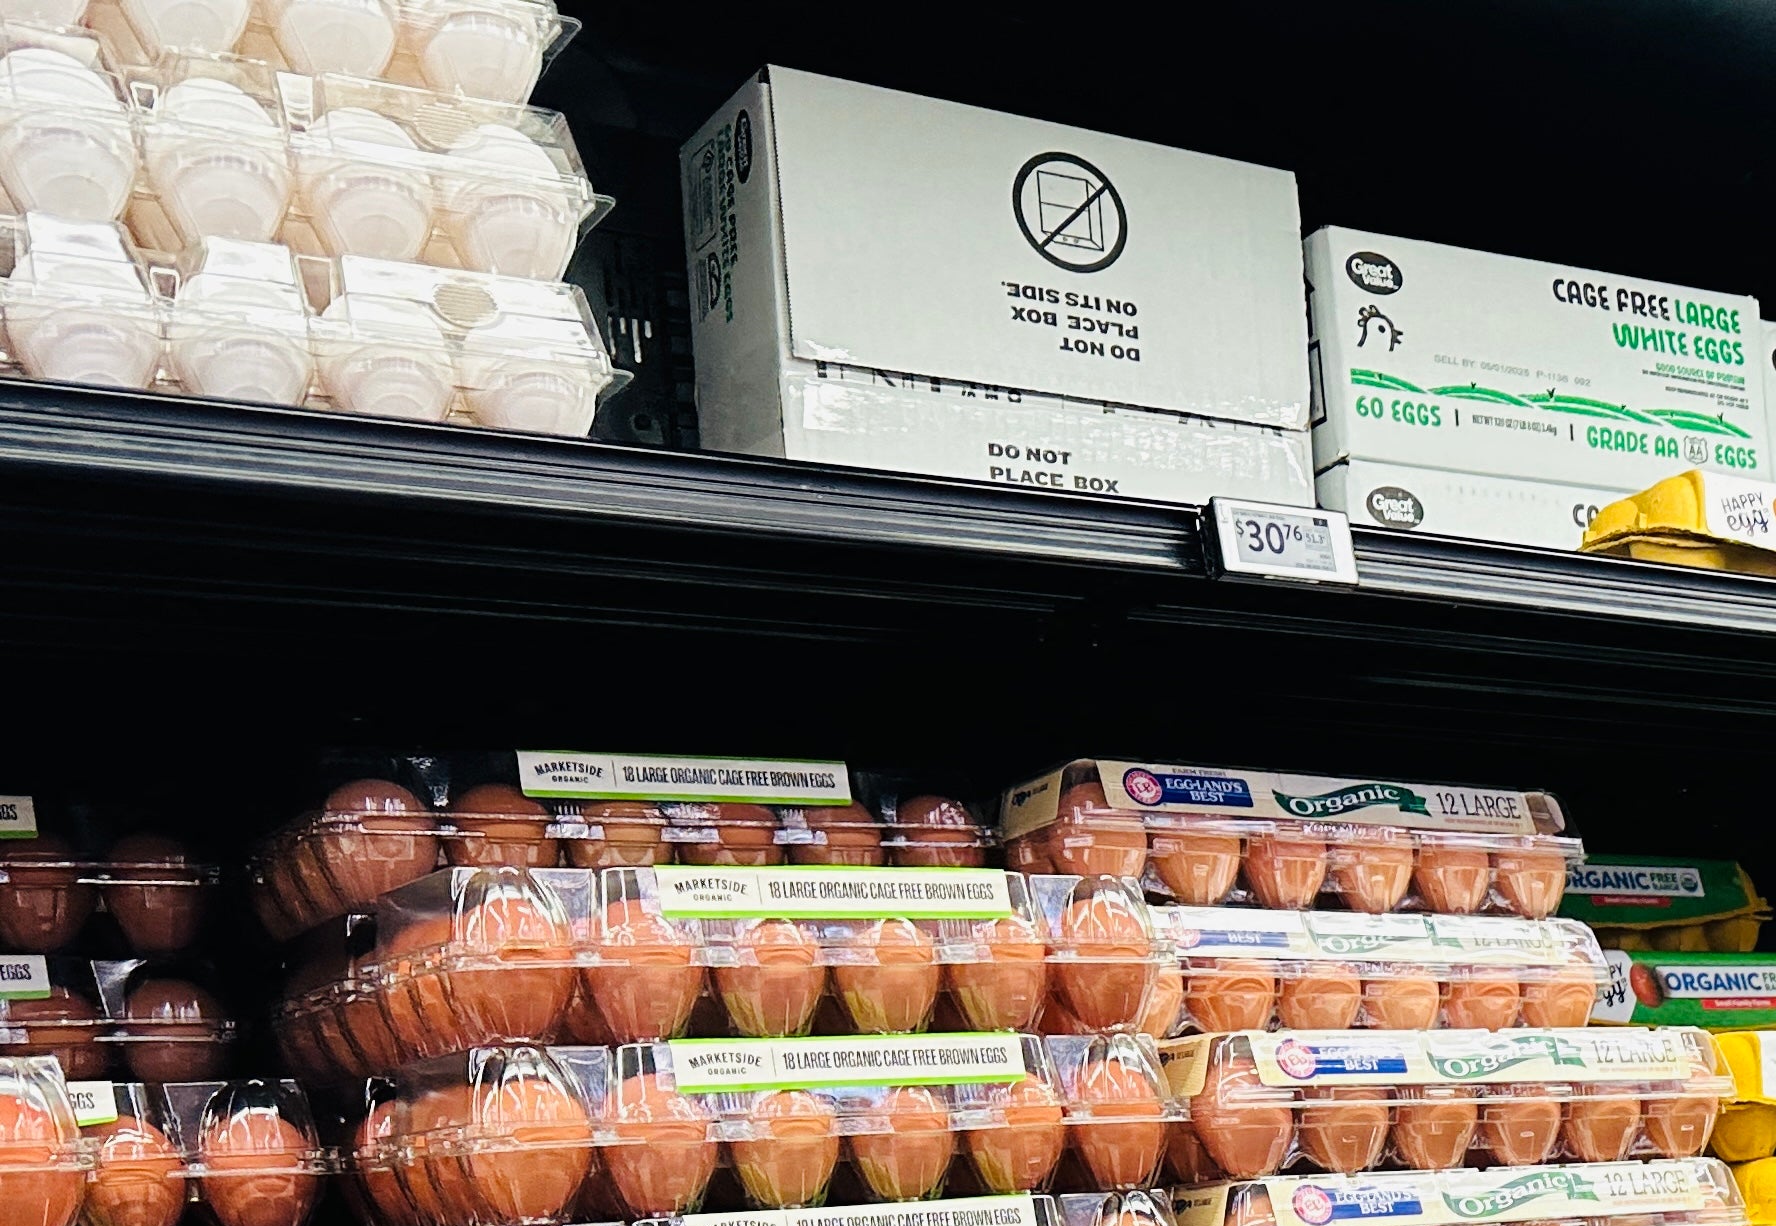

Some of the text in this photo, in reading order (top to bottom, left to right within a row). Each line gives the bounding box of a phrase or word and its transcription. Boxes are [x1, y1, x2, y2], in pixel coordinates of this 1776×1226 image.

[1351, 259, 1393, 279] Great
[1002, 281, 1137, 317] ON ITS SIDE.
[1553, 279, 1741, 334] CAGE FREE LARGE
[1011, 306, 1138, 339] PLACE BOX
[1060, 338, 1140, 362] DO NOT
[1612, 323, 1745, 366] WHITE EGGS
[1355, 396, 1441, 426] 60 EGGS
[988, 443, 1071, 467] DO NOT
[990, 467, 1119, 494] PLACE BOX
[1721, 492, 1763, 512] HAPPY
[1727, 509, 1769, 536] egg
[535, 761, 604, 778] MARKETSIDE
[622, 765, 835, 788] 18 LARGE ORGANIC CAGE FREE BROWN EGGS
[1190, 791, 1224, 802] BEST
[1290, 785, 1402, 816] Organic
[1436, 792, 1521, 820] 12 LARGE
[674, 877, 748, 895] MARKETSIDE
[1650, 872, 1678, 883] FREE
[768, 881, 994, 900] 18 LARGE ORGANIC CAGE FREE BROWN EGGS
[1228, 932, 1262, 944] BEST
[1664, 972, 1762, 992] ORGANIC
[688, 1052, 762, 1069] MARKETSIDE
[1444, 1037, 1556, 1077] Organic
[1592, 1039, 1677, 1064] 12 LARGE
[1344, 1059, 1379, 1072] BEST
[1459, 1174, 1568, 1217] Organic
[1605, 1170, 1688, 1197] 12 LARGE
[1361, 1201, 1394, 1215] BEST
